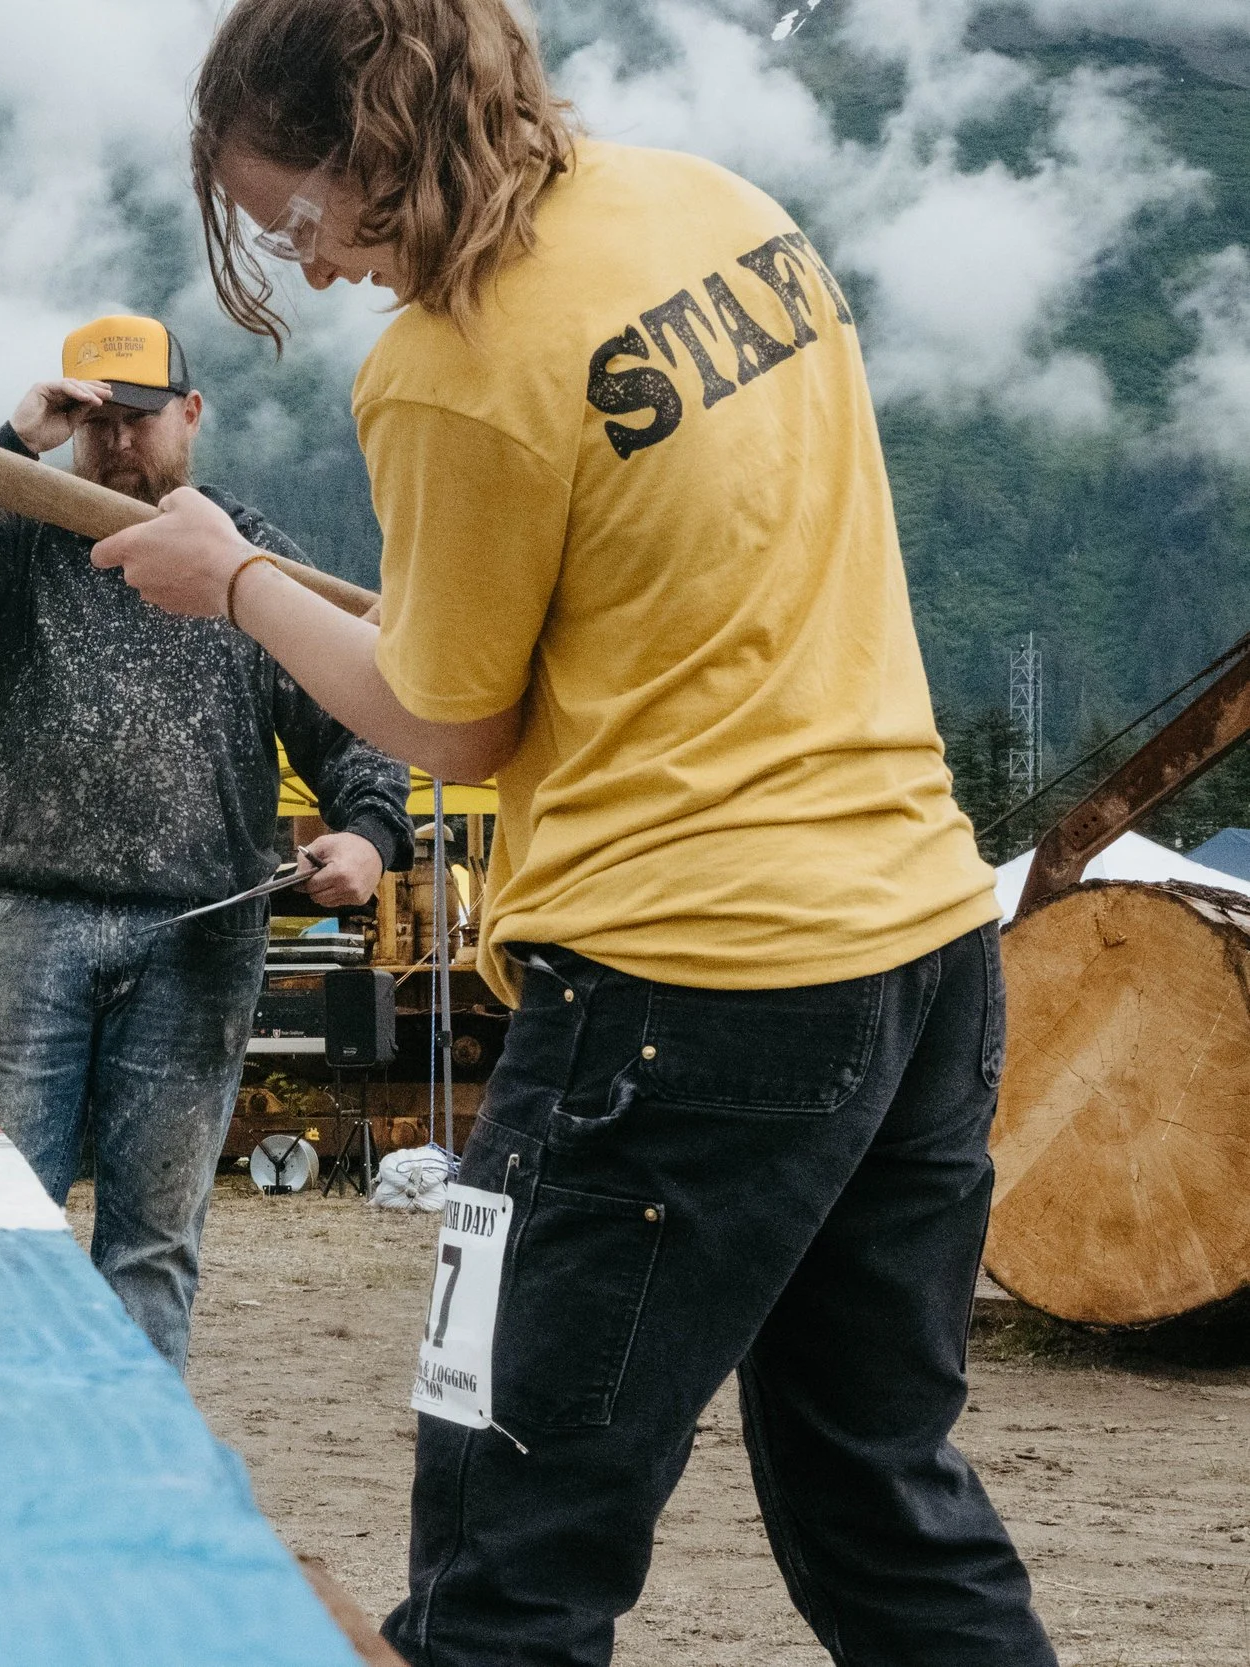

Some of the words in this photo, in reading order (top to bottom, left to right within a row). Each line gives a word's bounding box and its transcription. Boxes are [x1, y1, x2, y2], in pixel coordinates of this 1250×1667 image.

[103, 342, 123, 352] GOLD
[124, 342, 144, 351] RUSH
[461, 1203, 498, 1238] DAYS
[431, 1362, 478, 1393] LOGGING
